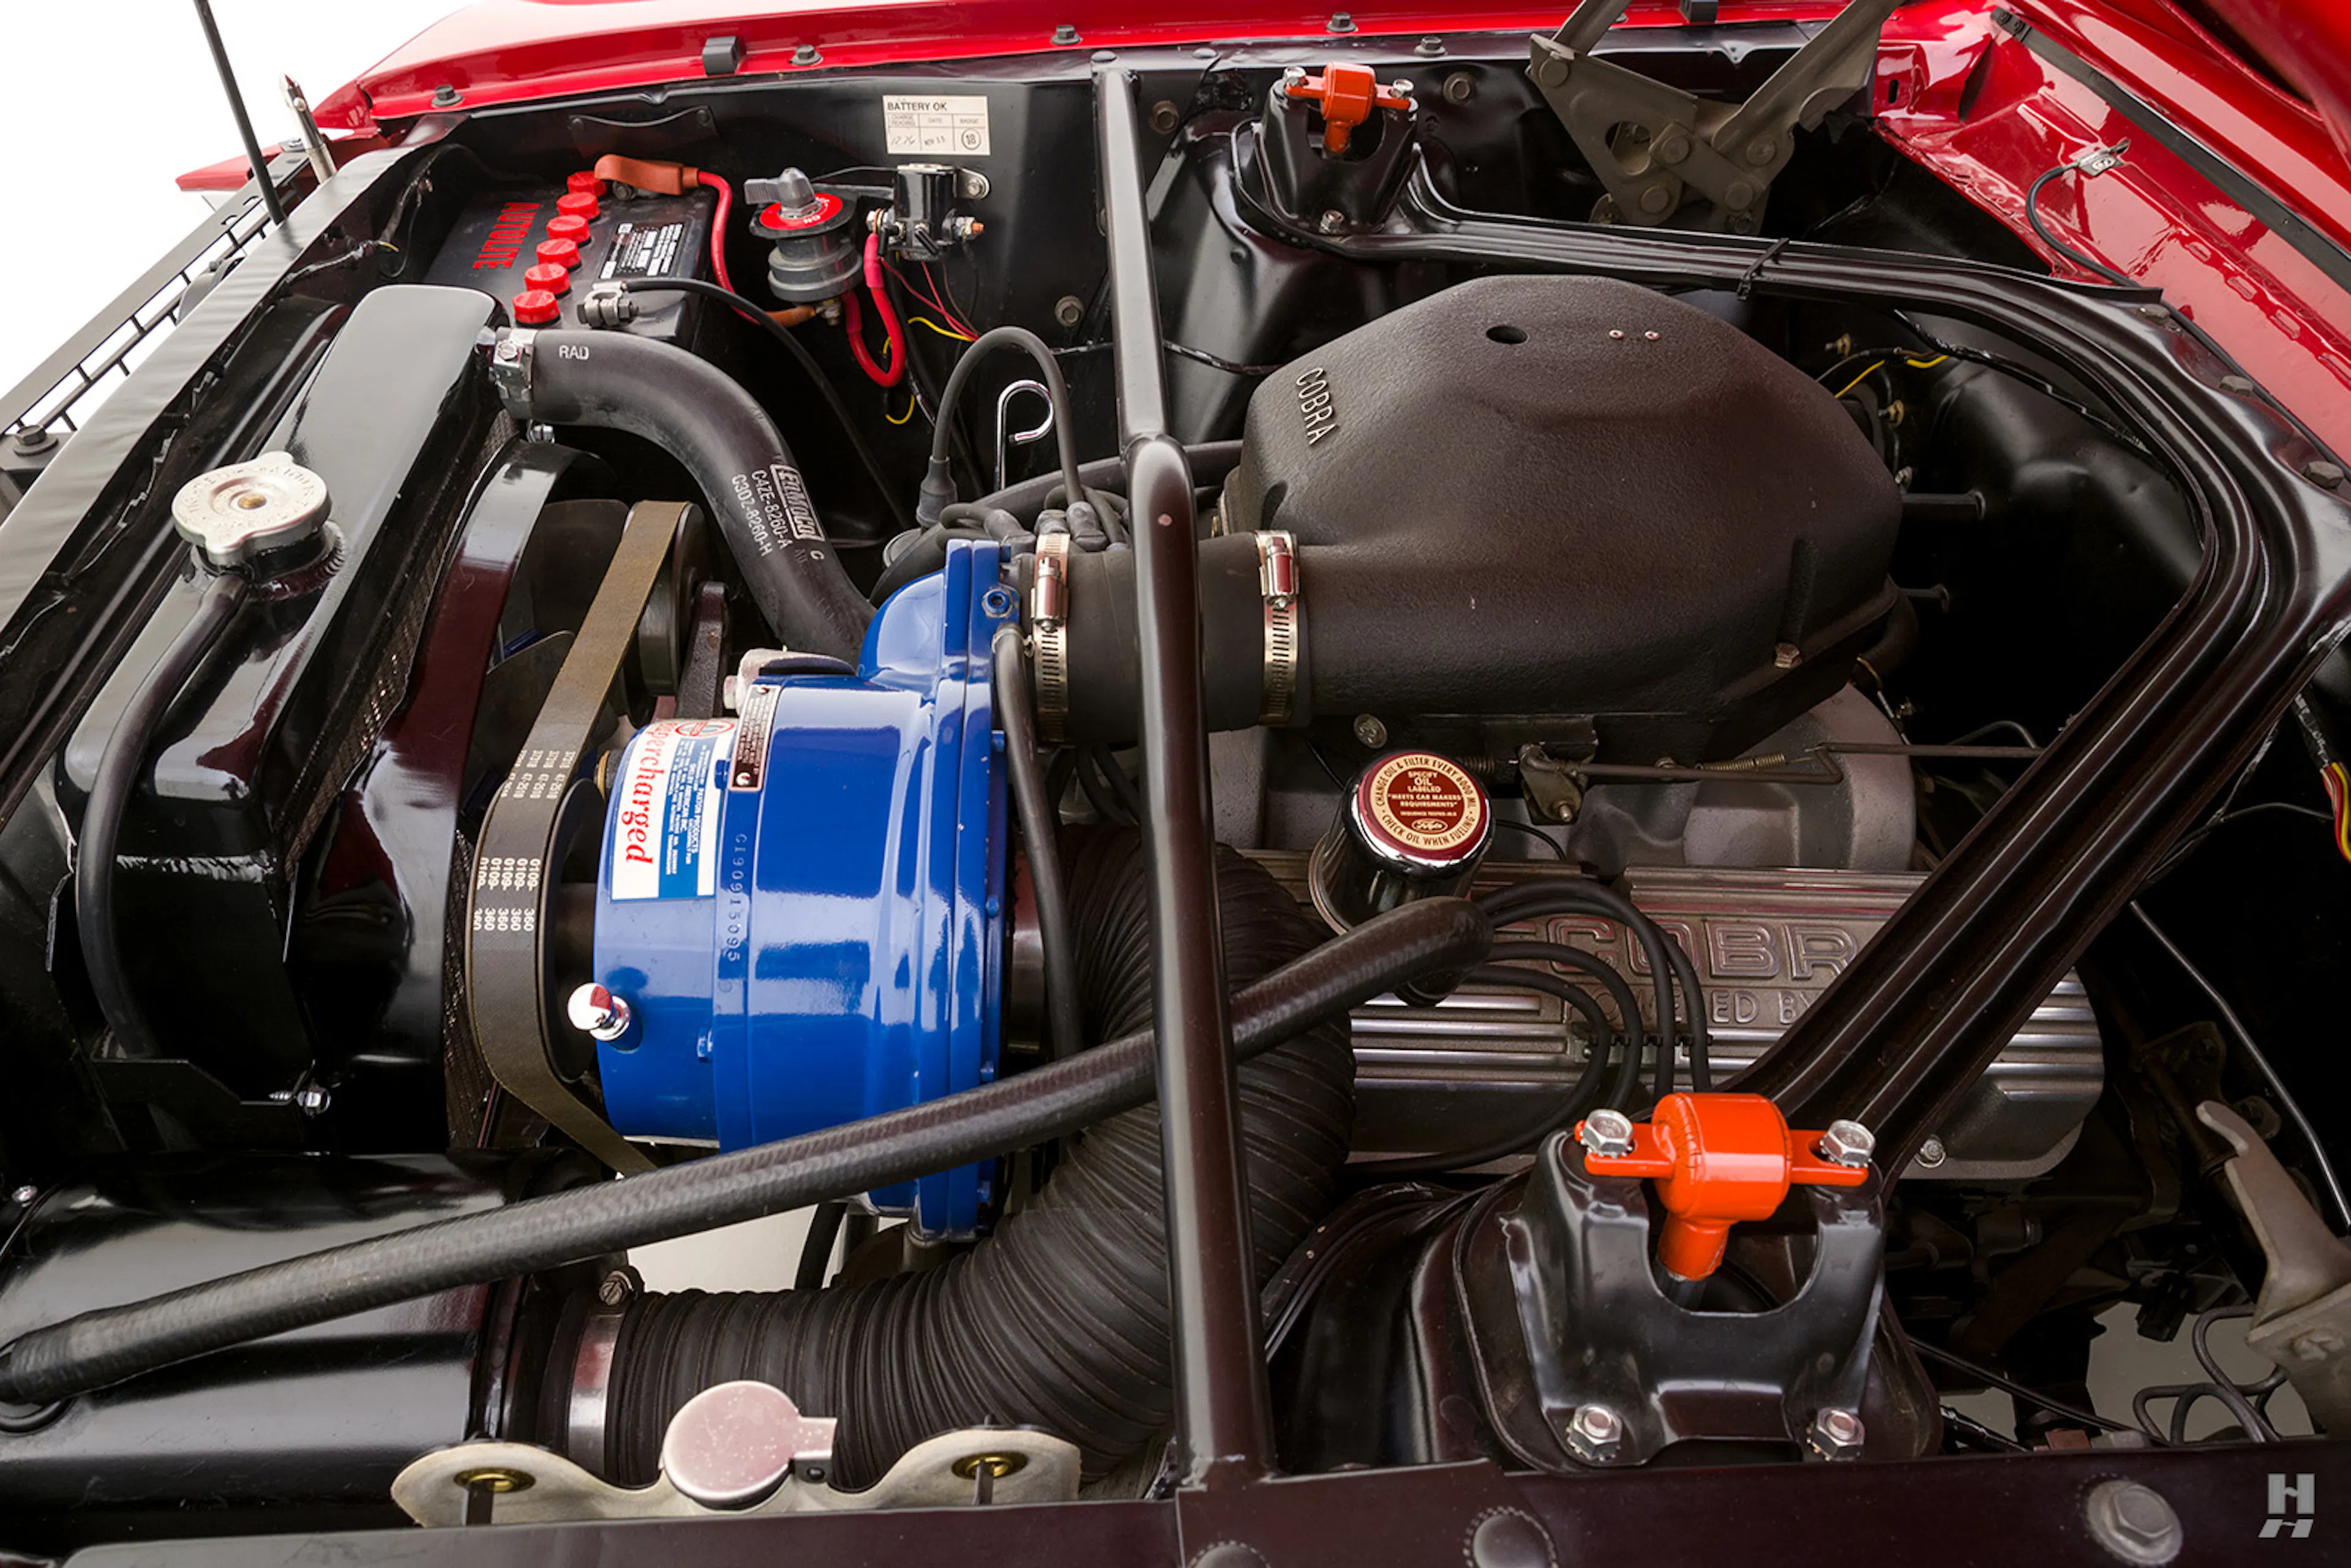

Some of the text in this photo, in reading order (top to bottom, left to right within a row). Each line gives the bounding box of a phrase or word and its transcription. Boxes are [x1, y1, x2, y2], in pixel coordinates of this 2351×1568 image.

[887, 102, 947, 111] BATTERY OK
[472, 201, 541, 269] AUTOLITE
[559, 345, 590, 360] RAD
[1295, 367, 1335, 445] COBRA
[1375, 776, 1387, 806] CHANGE
[1384, 768, 1397, 778] OIL
[1404, 757, 1429, 765] FILTER
[1432, 758, 1458, 776] EVERY
[1382, 814, 1475, 846] CHECK OIL WHEN FUELING
